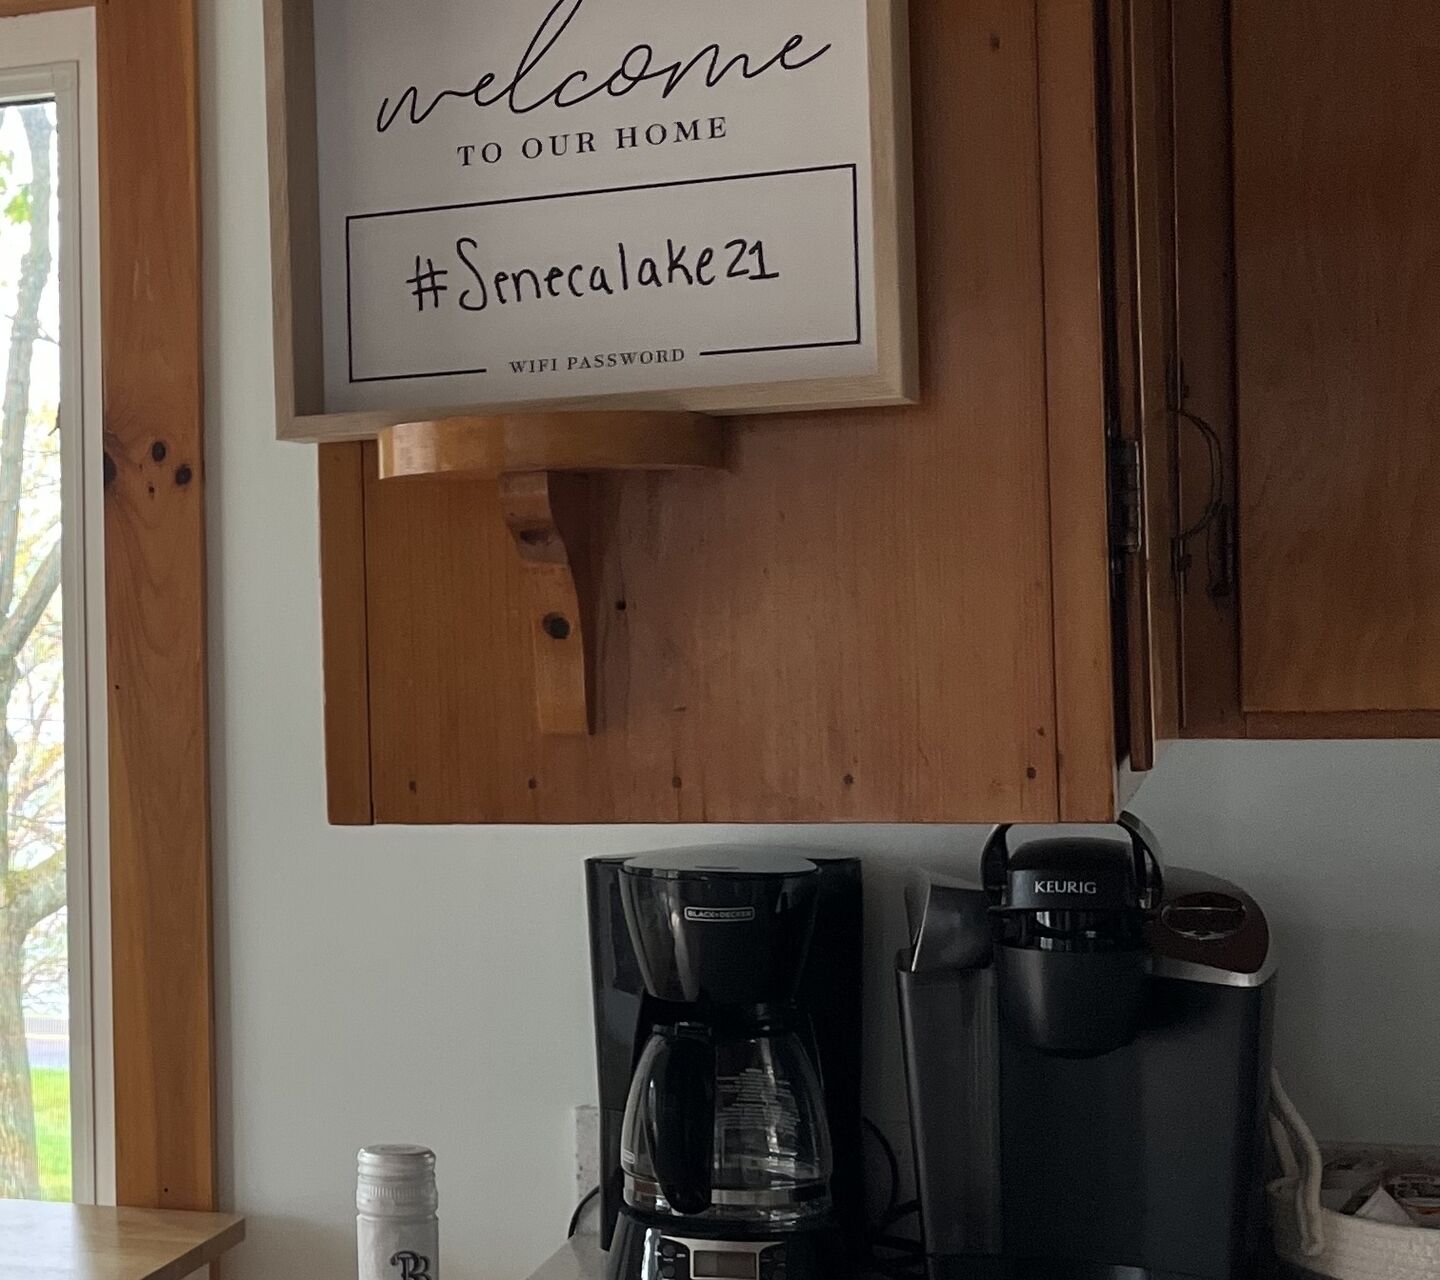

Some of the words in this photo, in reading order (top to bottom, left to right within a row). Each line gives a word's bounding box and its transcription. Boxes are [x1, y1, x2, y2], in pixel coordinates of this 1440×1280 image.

[456, 141, 503, 167] TO
[521, 132, 597, 159] OUR
[615, 116, 728, 149] HOME
[509, 357, 558, 375] WIFI
[566, 348, 686, 371] PASSWORD
[1034, 880, 1097, 894] KEURIG
